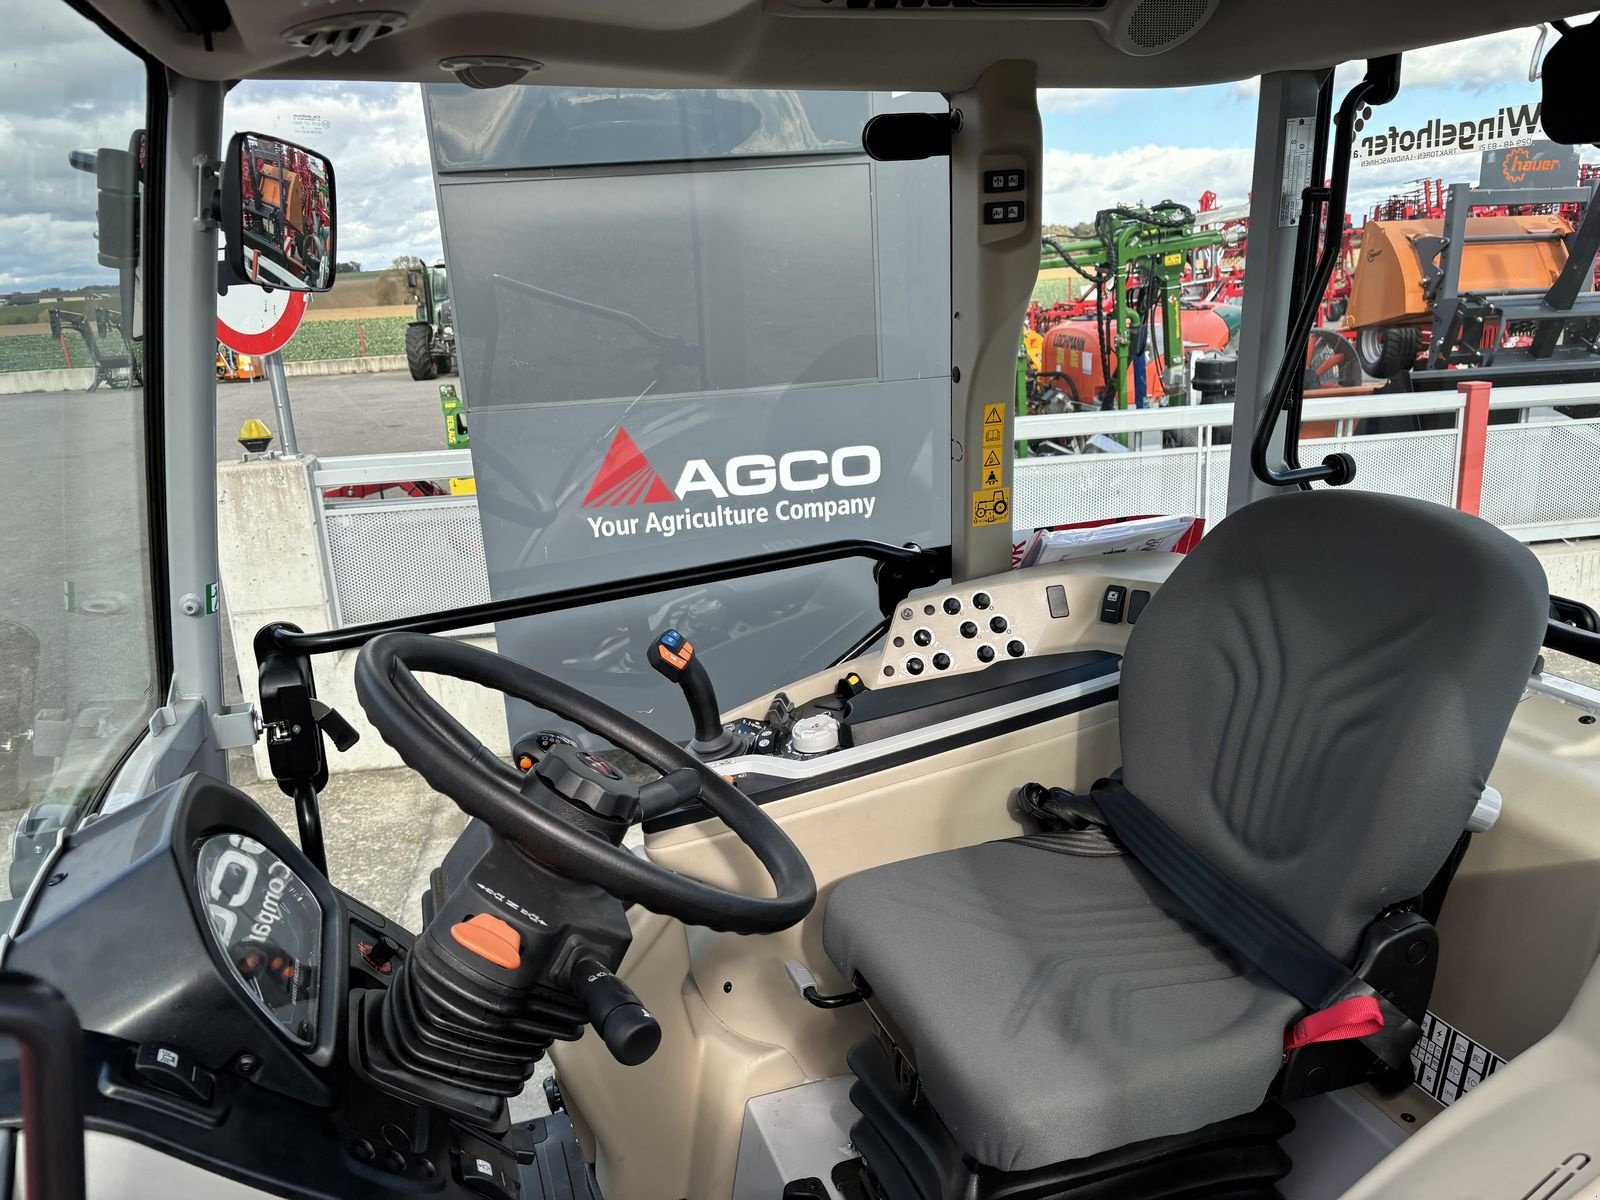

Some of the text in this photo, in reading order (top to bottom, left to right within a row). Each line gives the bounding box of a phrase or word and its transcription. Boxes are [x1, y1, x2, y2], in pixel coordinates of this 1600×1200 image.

[1511, 156, 1560, 172] hauer
[675, 445, 881, 501] AGCO
[587, 496, 876, 538] Your Agriculture Company
